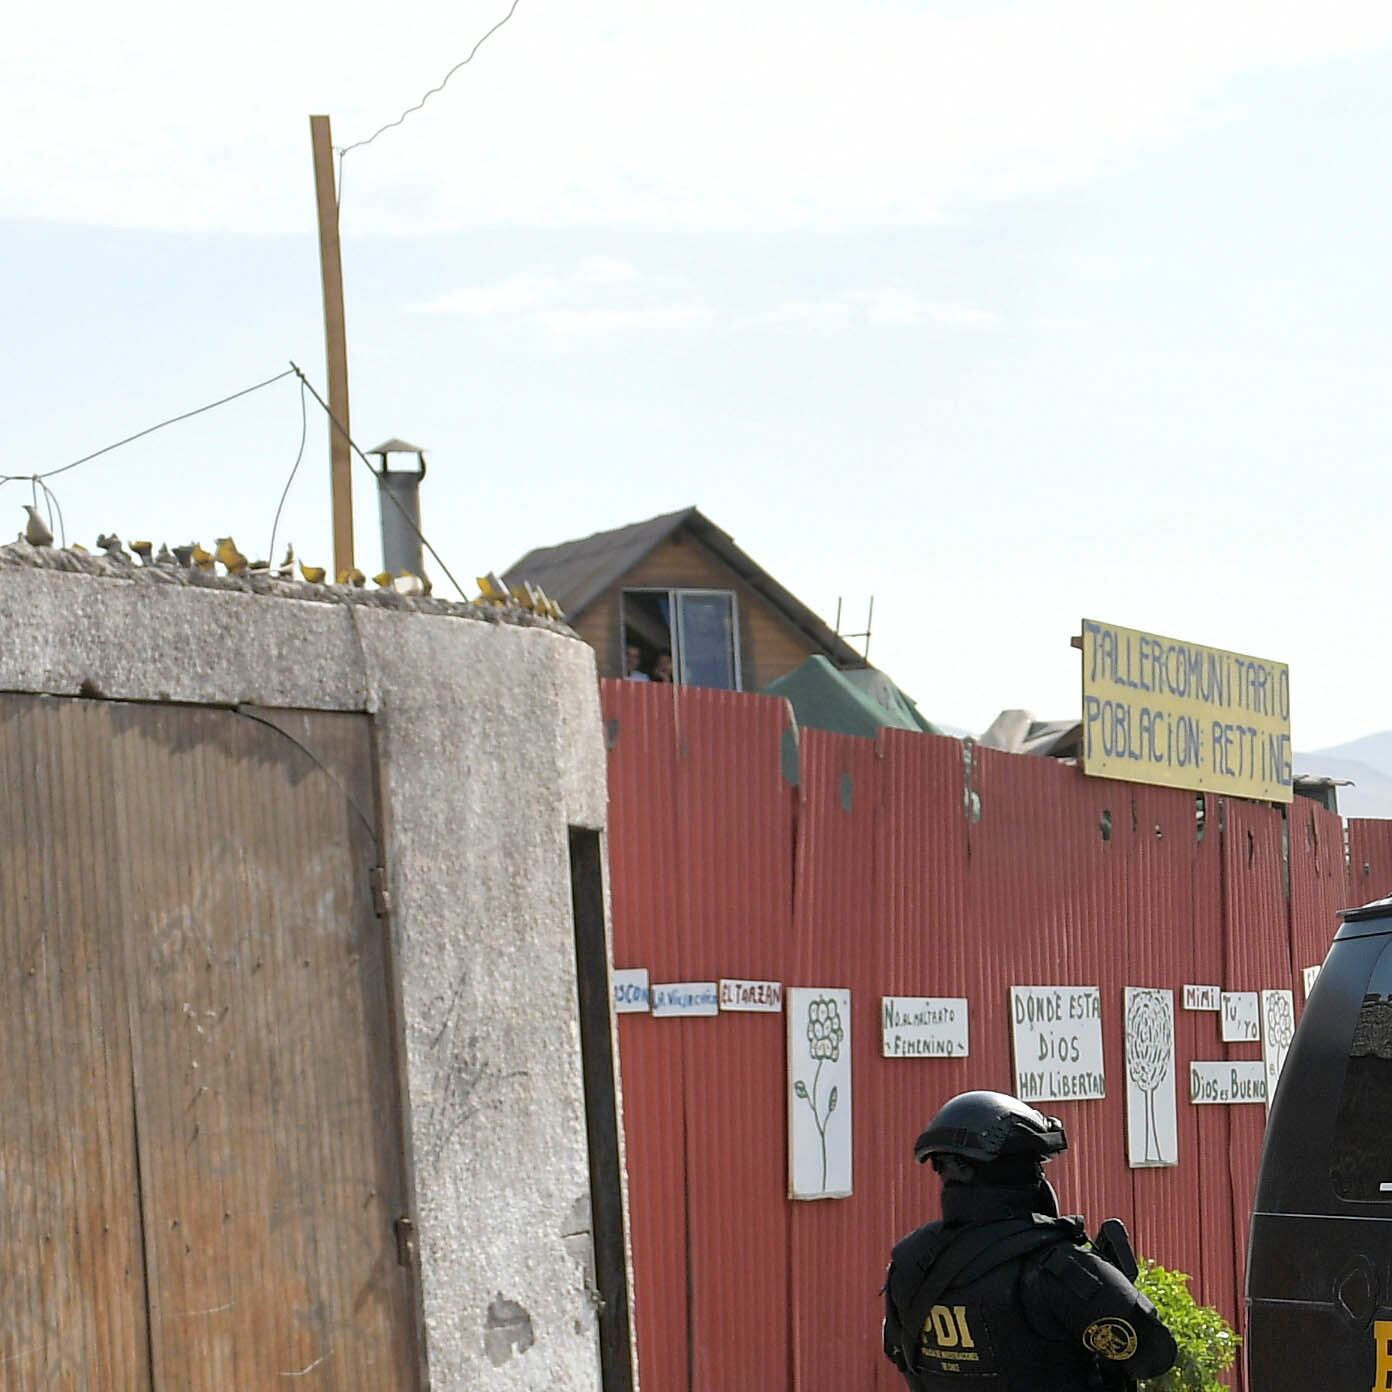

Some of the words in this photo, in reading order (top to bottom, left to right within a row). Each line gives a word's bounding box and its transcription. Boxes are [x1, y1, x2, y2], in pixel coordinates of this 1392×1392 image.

[1015, 993, 1062, 1025] DONDE
[1070, 992, 1100, 1020] ESTA
[1020, 1072, 1044, 1099] HAY
